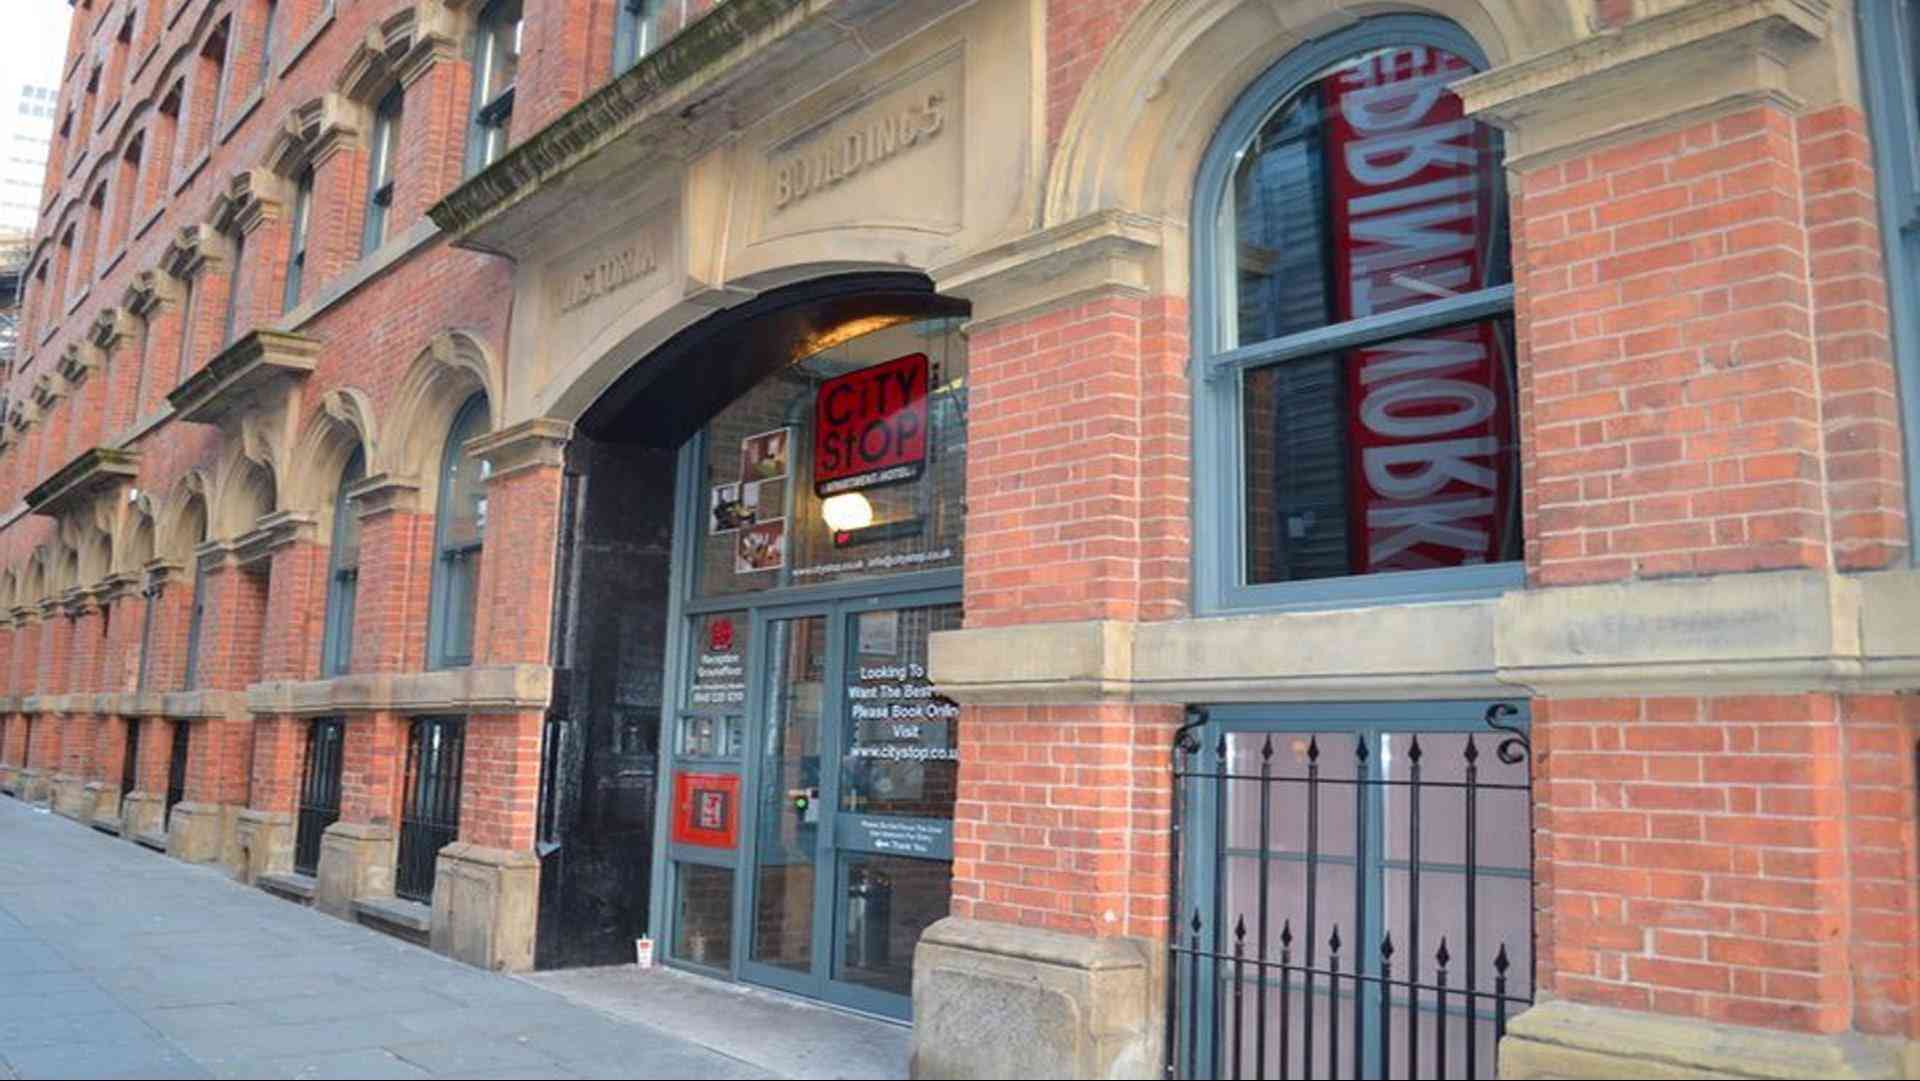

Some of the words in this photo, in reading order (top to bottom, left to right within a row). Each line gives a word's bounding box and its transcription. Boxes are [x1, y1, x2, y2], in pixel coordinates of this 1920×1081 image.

[775, 95, 945, 209] BUILDINGS
[859, 666, 907, 684] Looking
[909, 663, 924, 679] To
[848, 682, 878, 699] Want
[880, 682, 902, 698] The
[852, 703, 889, 719] Please
[892, 704, 923, 719] Book
[926, 703, 959, 719] Onlin
[892, 725, 918, 740] Visit
[850, 743, 959, 762] www.citystop.co.u
